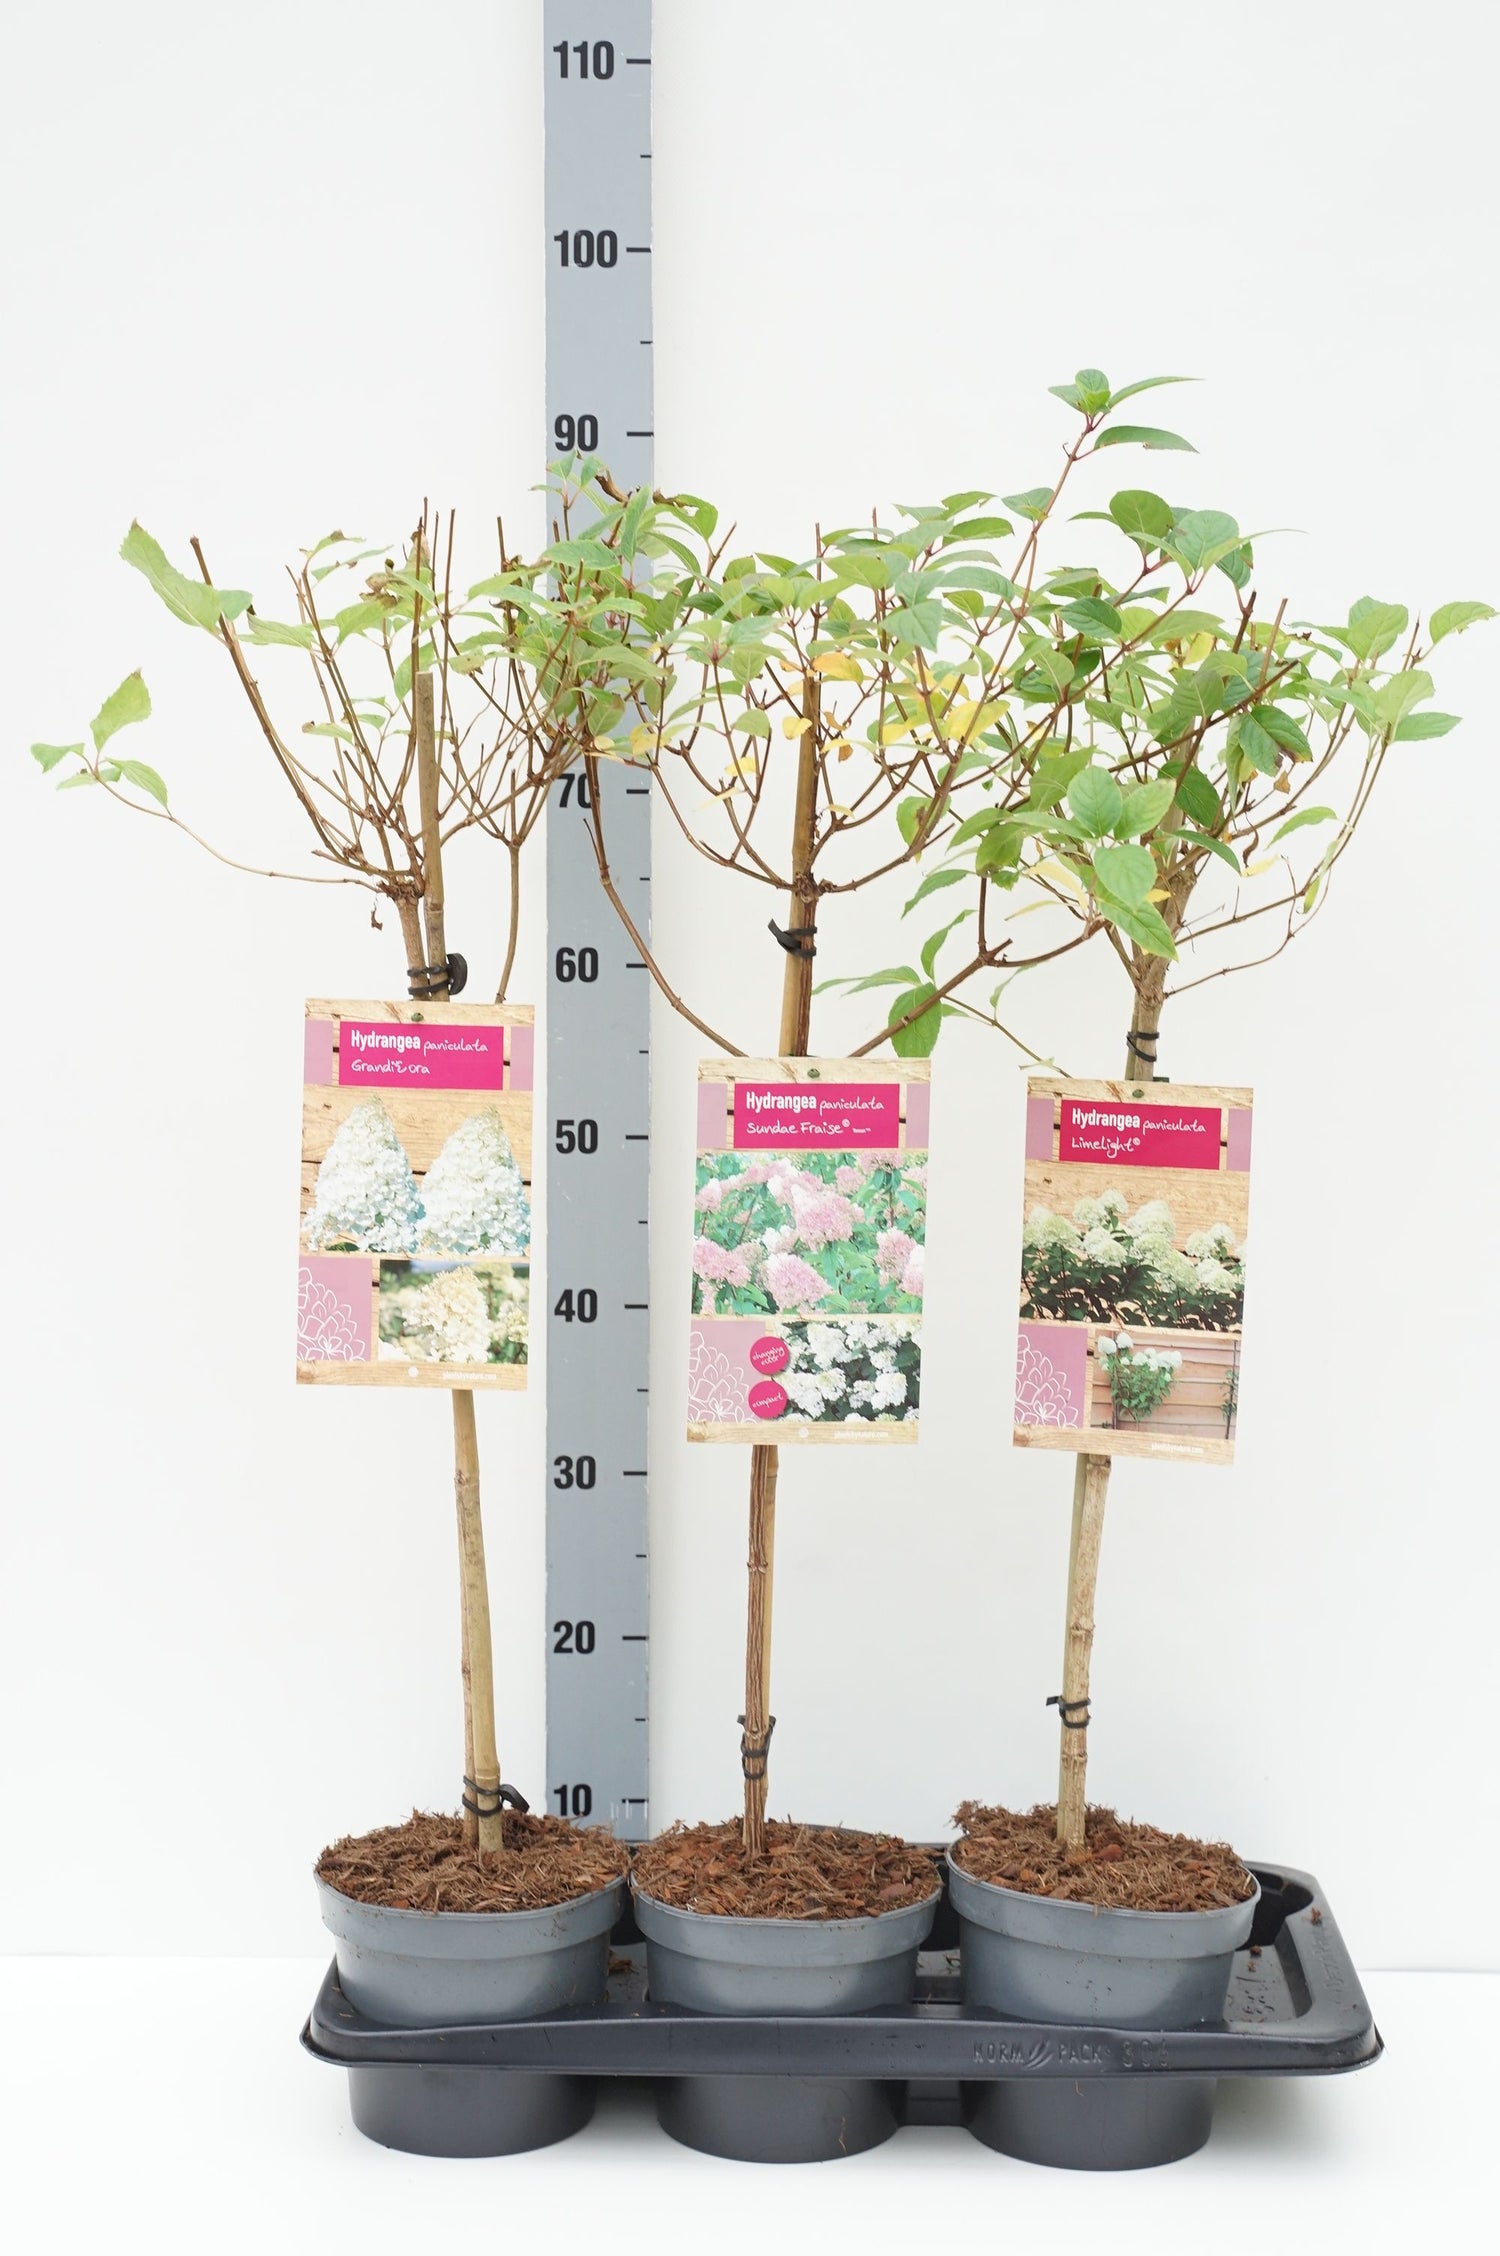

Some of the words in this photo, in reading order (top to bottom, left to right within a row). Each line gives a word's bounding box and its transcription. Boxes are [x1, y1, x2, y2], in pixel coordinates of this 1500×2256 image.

[553, 40, 615, 80] 110
[554, 229, 618, 268] 100
[554, 414, 599, 452] 90
[555, 947, 599, 982] 60
[351, 1029, 421, 1053] Hydrangea
[423, 1038, 489, 1056] paniculata
[746, 1091, 817, 1114] Hydrangea
[819, 1096, 886, 1117] paniculata
[1071, 1107, 1141, 1132] Hydrangea
[1142, 1118, 1207, 1136] paniculata
[555, 1119, 598, 1154] 50
[746, 1119, 798, 1135] Sundae
[554, 1288, 598, 1323] 40
[553, 1455, 597, 1490] 30
[553, 1620, 596, 1655] 20
[553, 1784, 592, 1817] 10
[972, 2040, 1024, 2064] NORM
